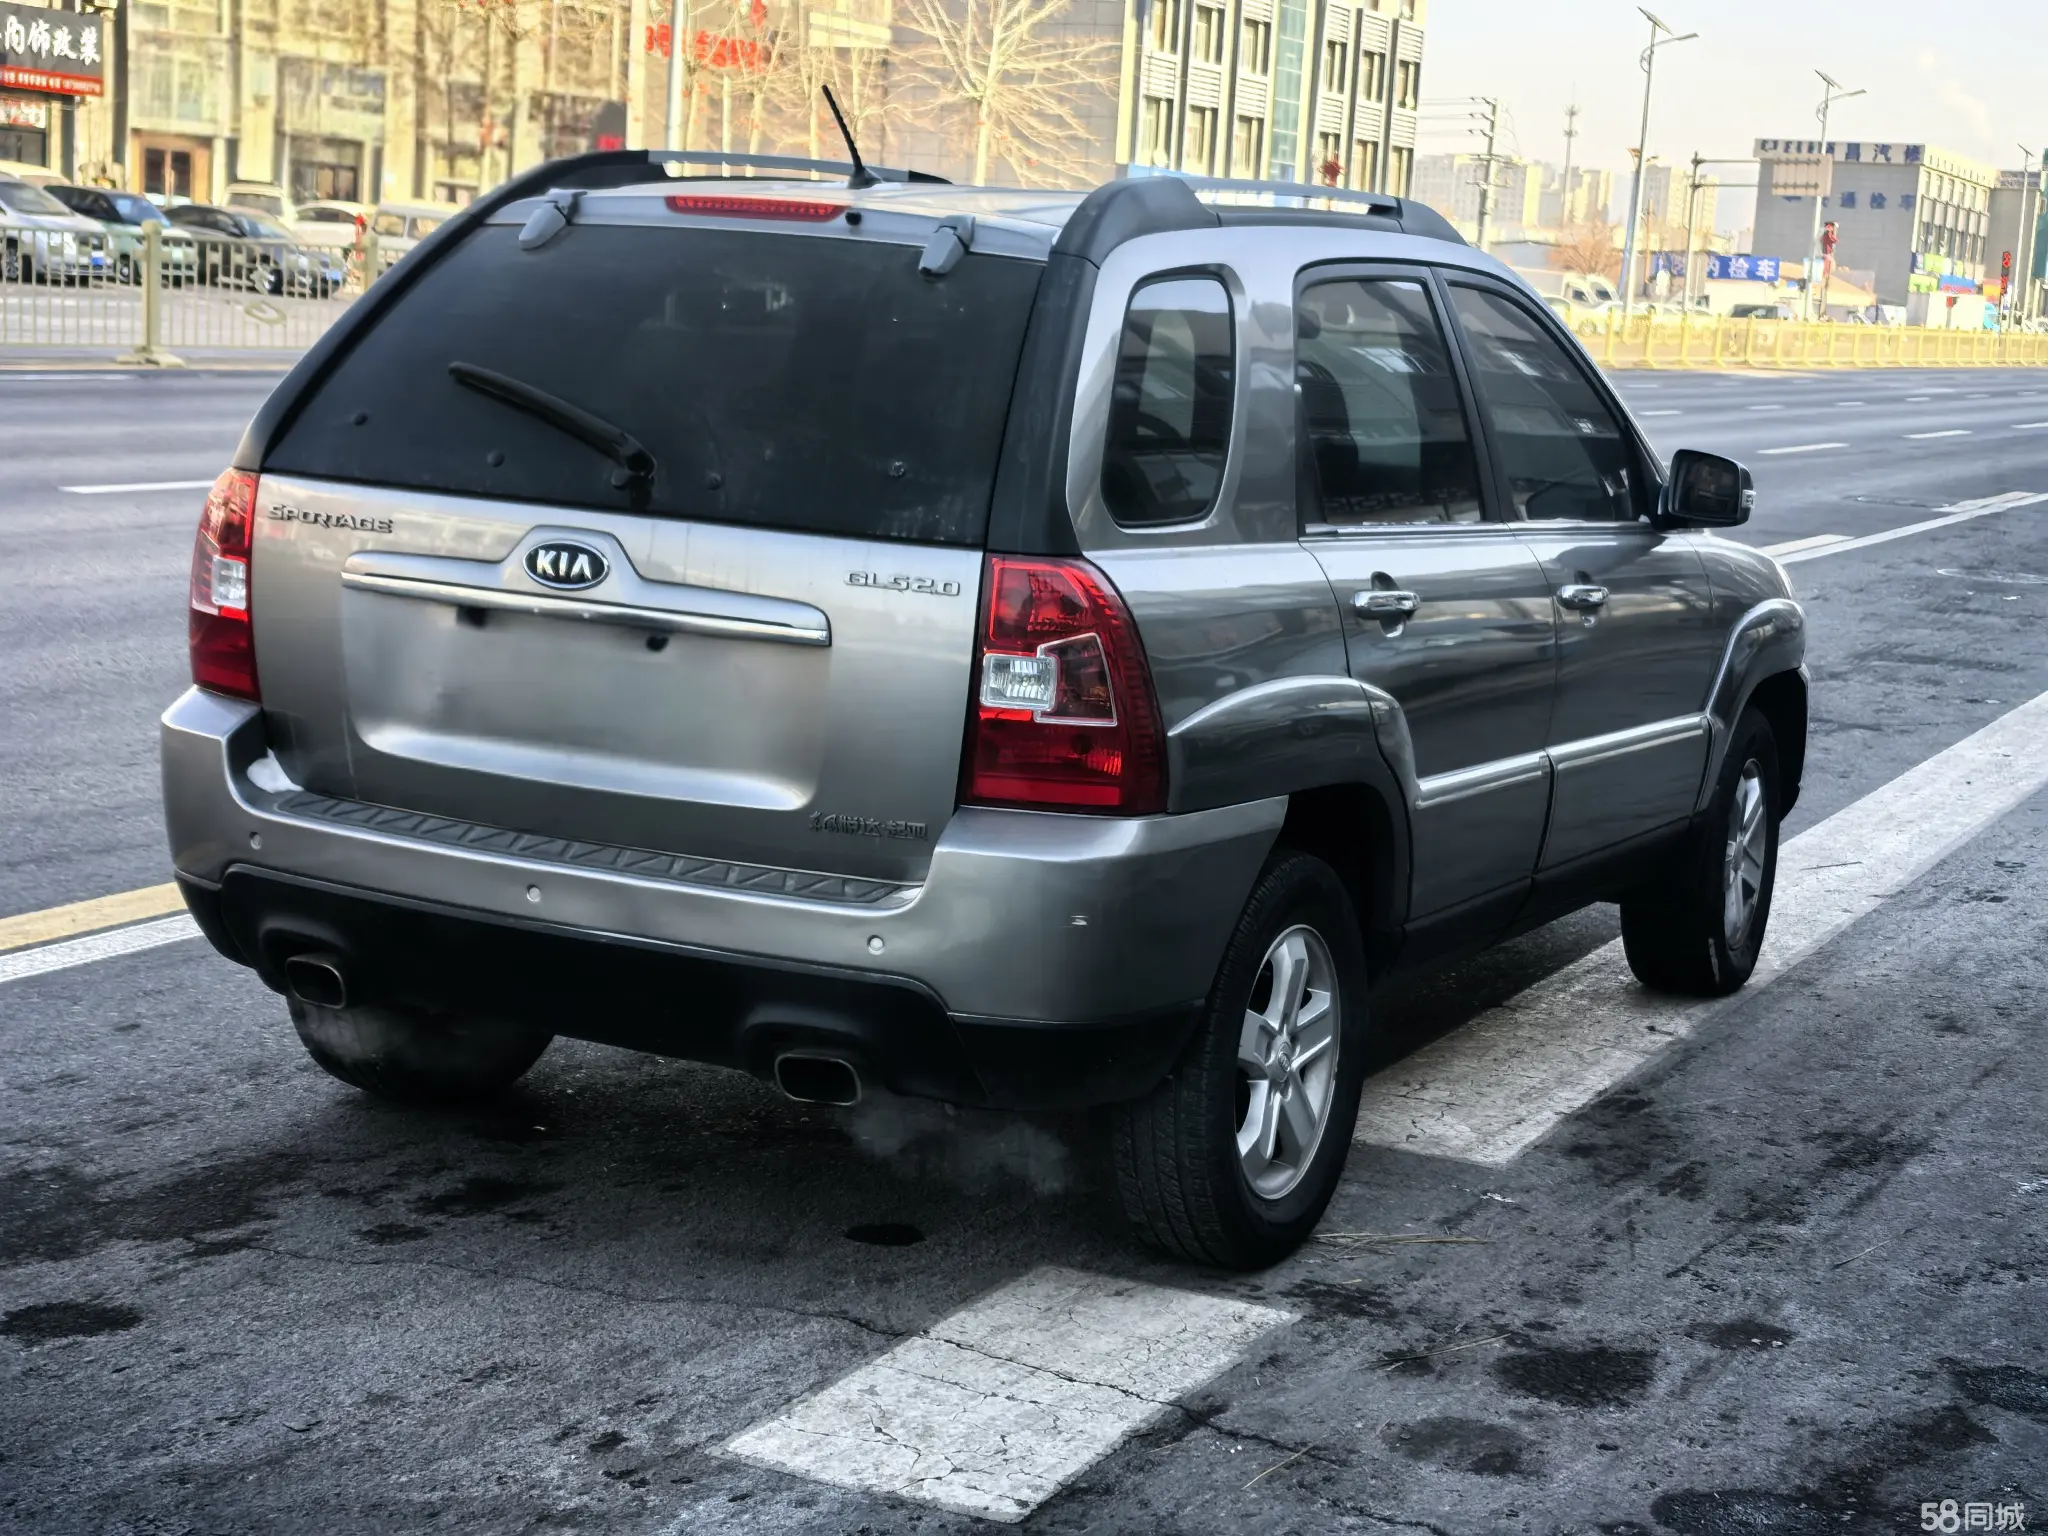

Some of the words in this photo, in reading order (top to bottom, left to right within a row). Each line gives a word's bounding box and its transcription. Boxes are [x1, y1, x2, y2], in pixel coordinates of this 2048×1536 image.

[0, 15, 101, 65] 内饰改装
[268, 503, 394, 534] SPORTAGE
[536, 549, 592, 580] KIA
